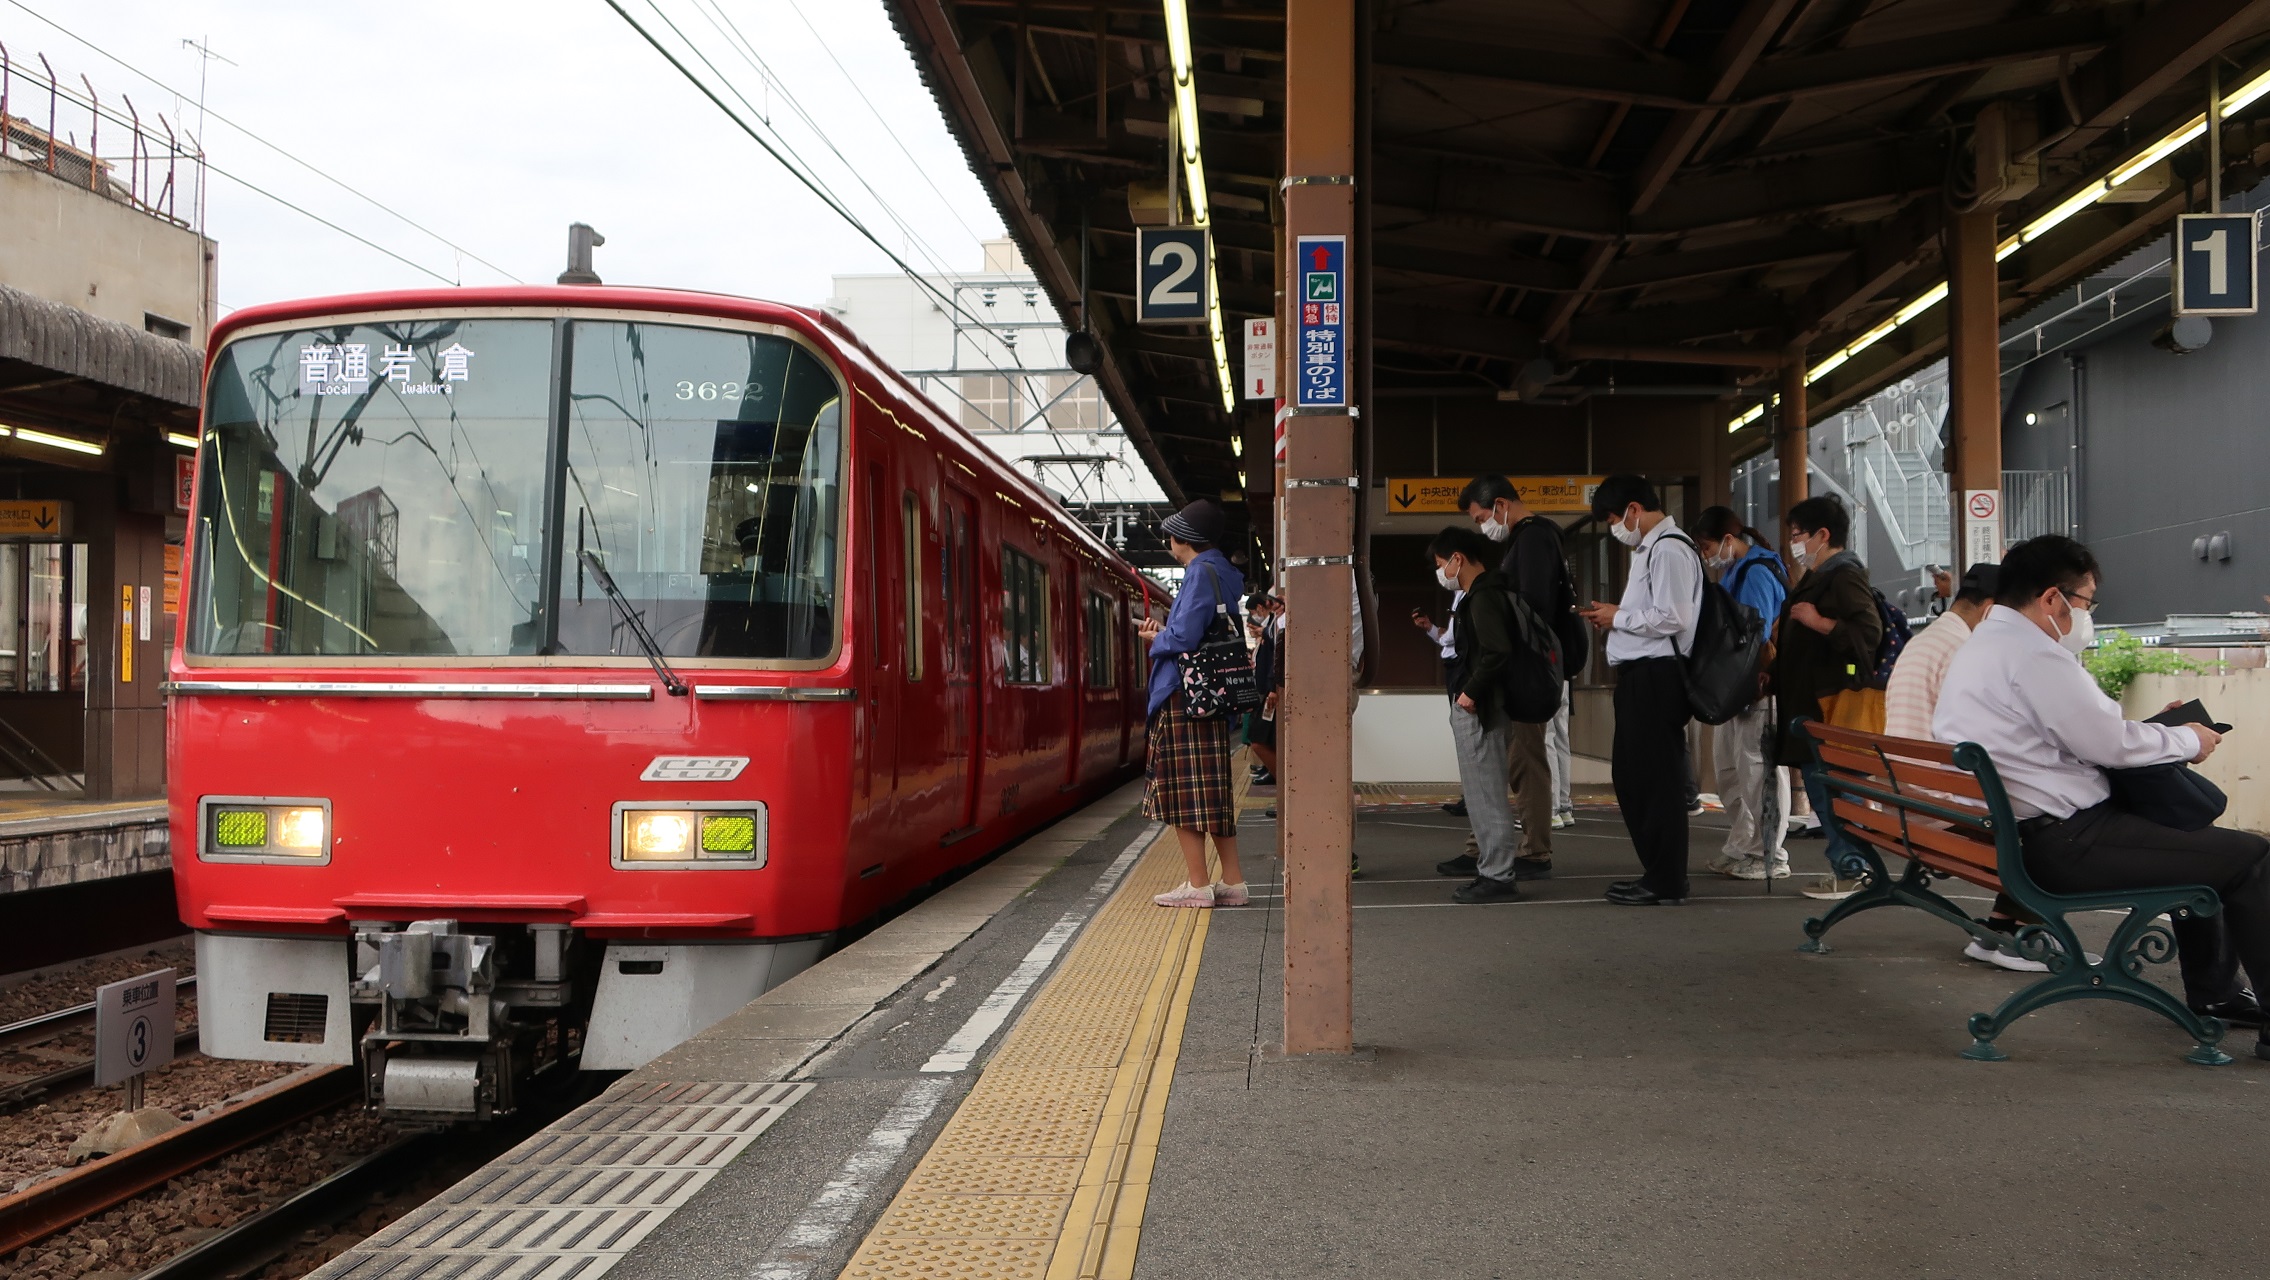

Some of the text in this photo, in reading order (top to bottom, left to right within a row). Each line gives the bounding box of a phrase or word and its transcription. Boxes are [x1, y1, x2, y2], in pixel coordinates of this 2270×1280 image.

[1148, 241, 1198, 305] 2
[2191, 229, 2228, 295] 1
[1305, 303, 1319, 324] 特急
[1325, 304, 1338, 323] 快特
[300, 344, 368, 382] 普通
[1306, 329, 1337, 399] 特別車のりば
[317, 381, 453, 395] Local Iwakura
[675, 380, 764, 401] 3622
[1420, 486, 1460, 498] 中央改札
[1983, 526, 1992, 564] 終日構内
[1225, 676, 1245, 686] New
[122, 981, 159, 1007] 乗車位置
